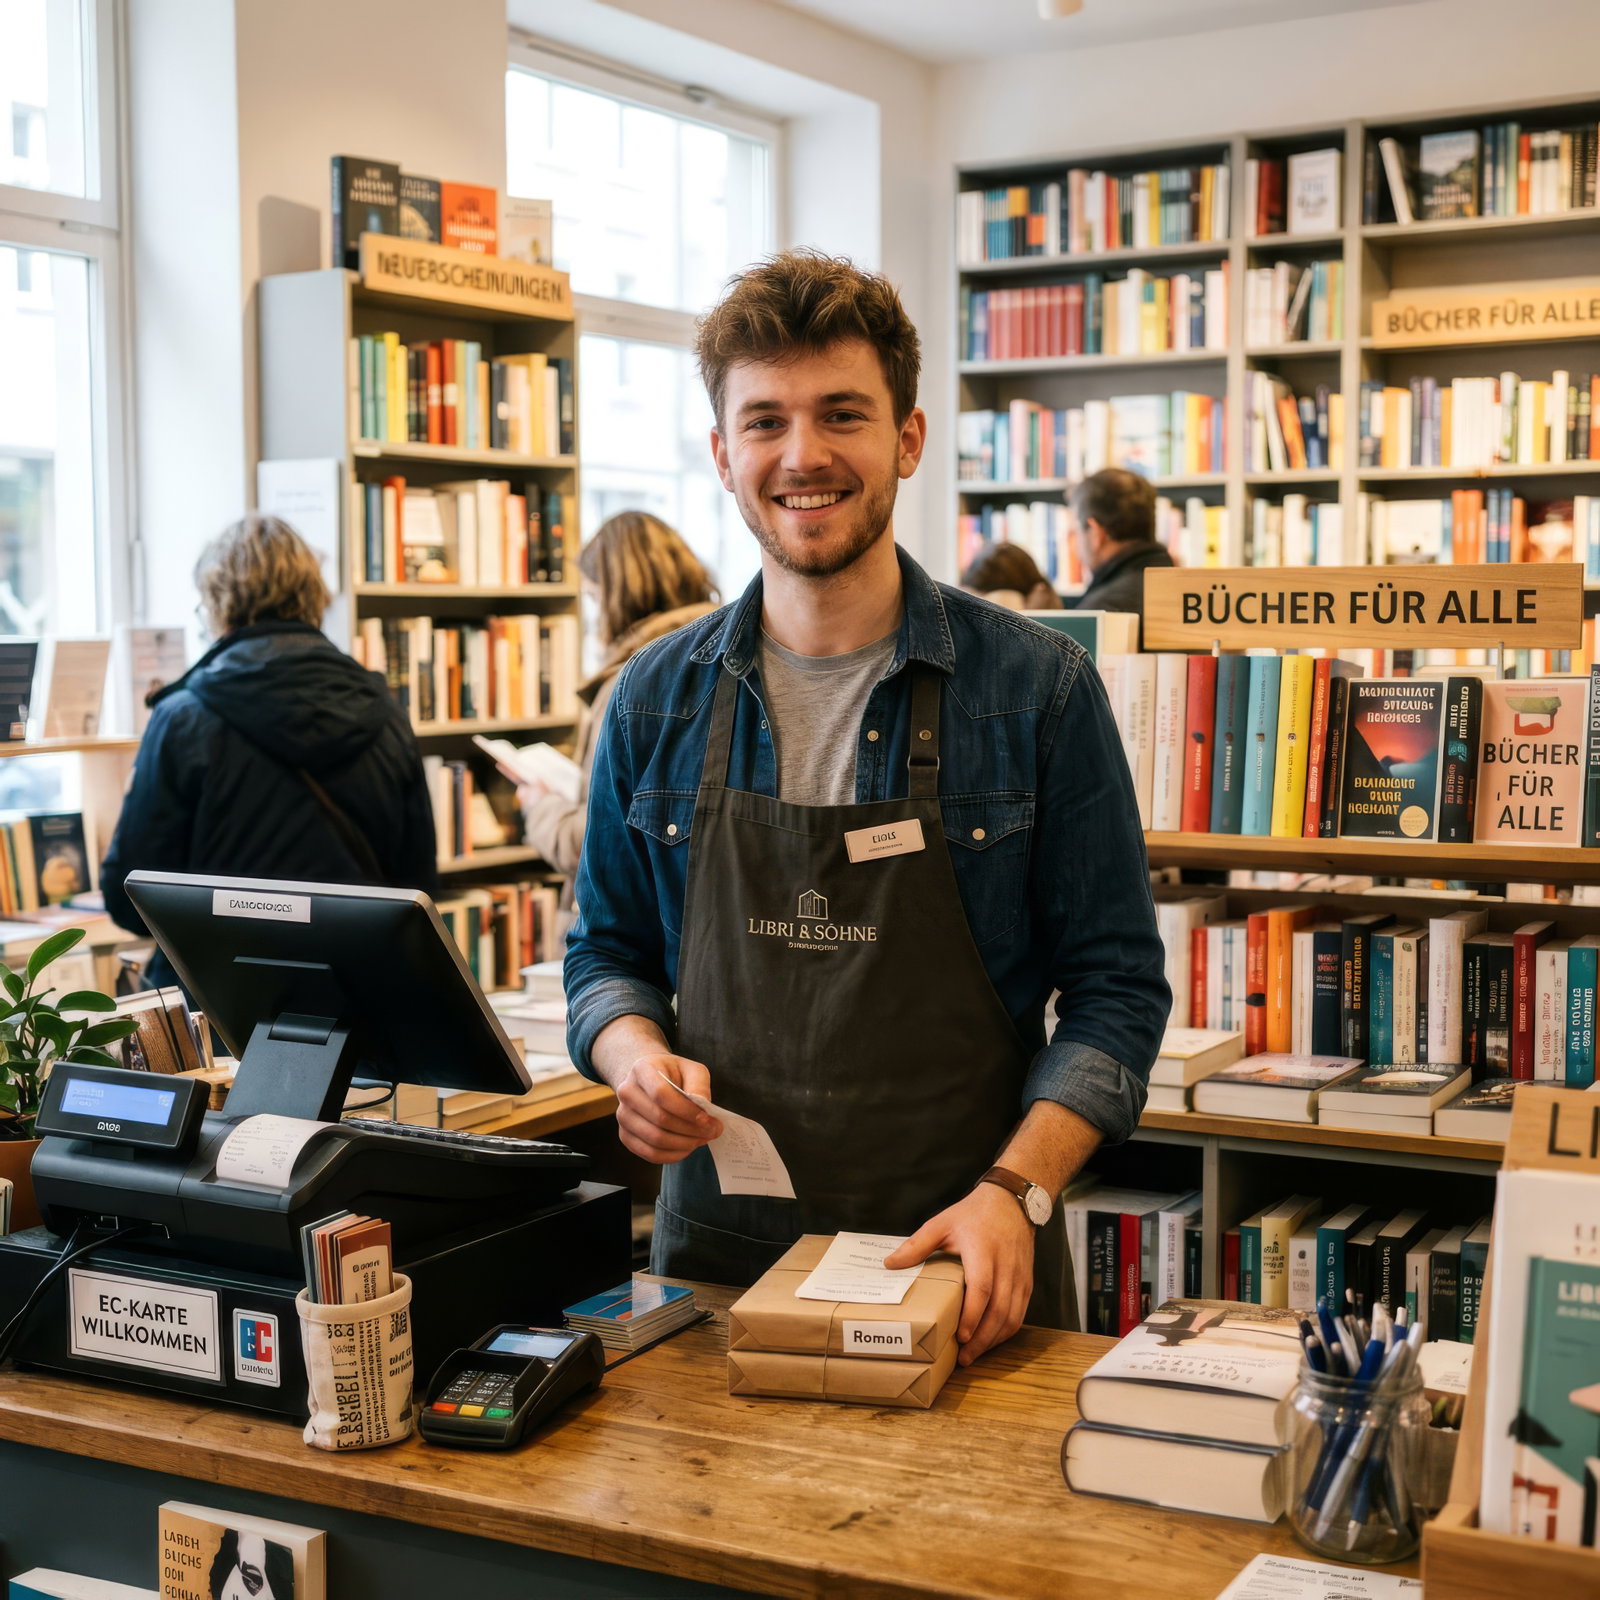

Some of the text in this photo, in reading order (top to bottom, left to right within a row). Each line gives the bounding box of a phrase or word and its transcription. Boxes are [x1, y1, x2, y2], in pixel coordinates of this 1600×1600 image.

[1387, 305, 1481, 333] BÜCHER
[1489, 298, 1535, 326] FÜR
[1182, 582, 1537, 625] BÜCHER FÜR ALLE
[1483, 737, 1579, 765] BÜCHER
[1508, 770, 1554, 796] FÜR
[1497, 805, 1565, 831] ALLE
[748, 918, 794, 937] LIBRI
[799, 924, 811, 939] &
[98, 1294, 188, 1326] EC-KARTE
[82, 1316, 207, 1355] WILLKOMMEN
